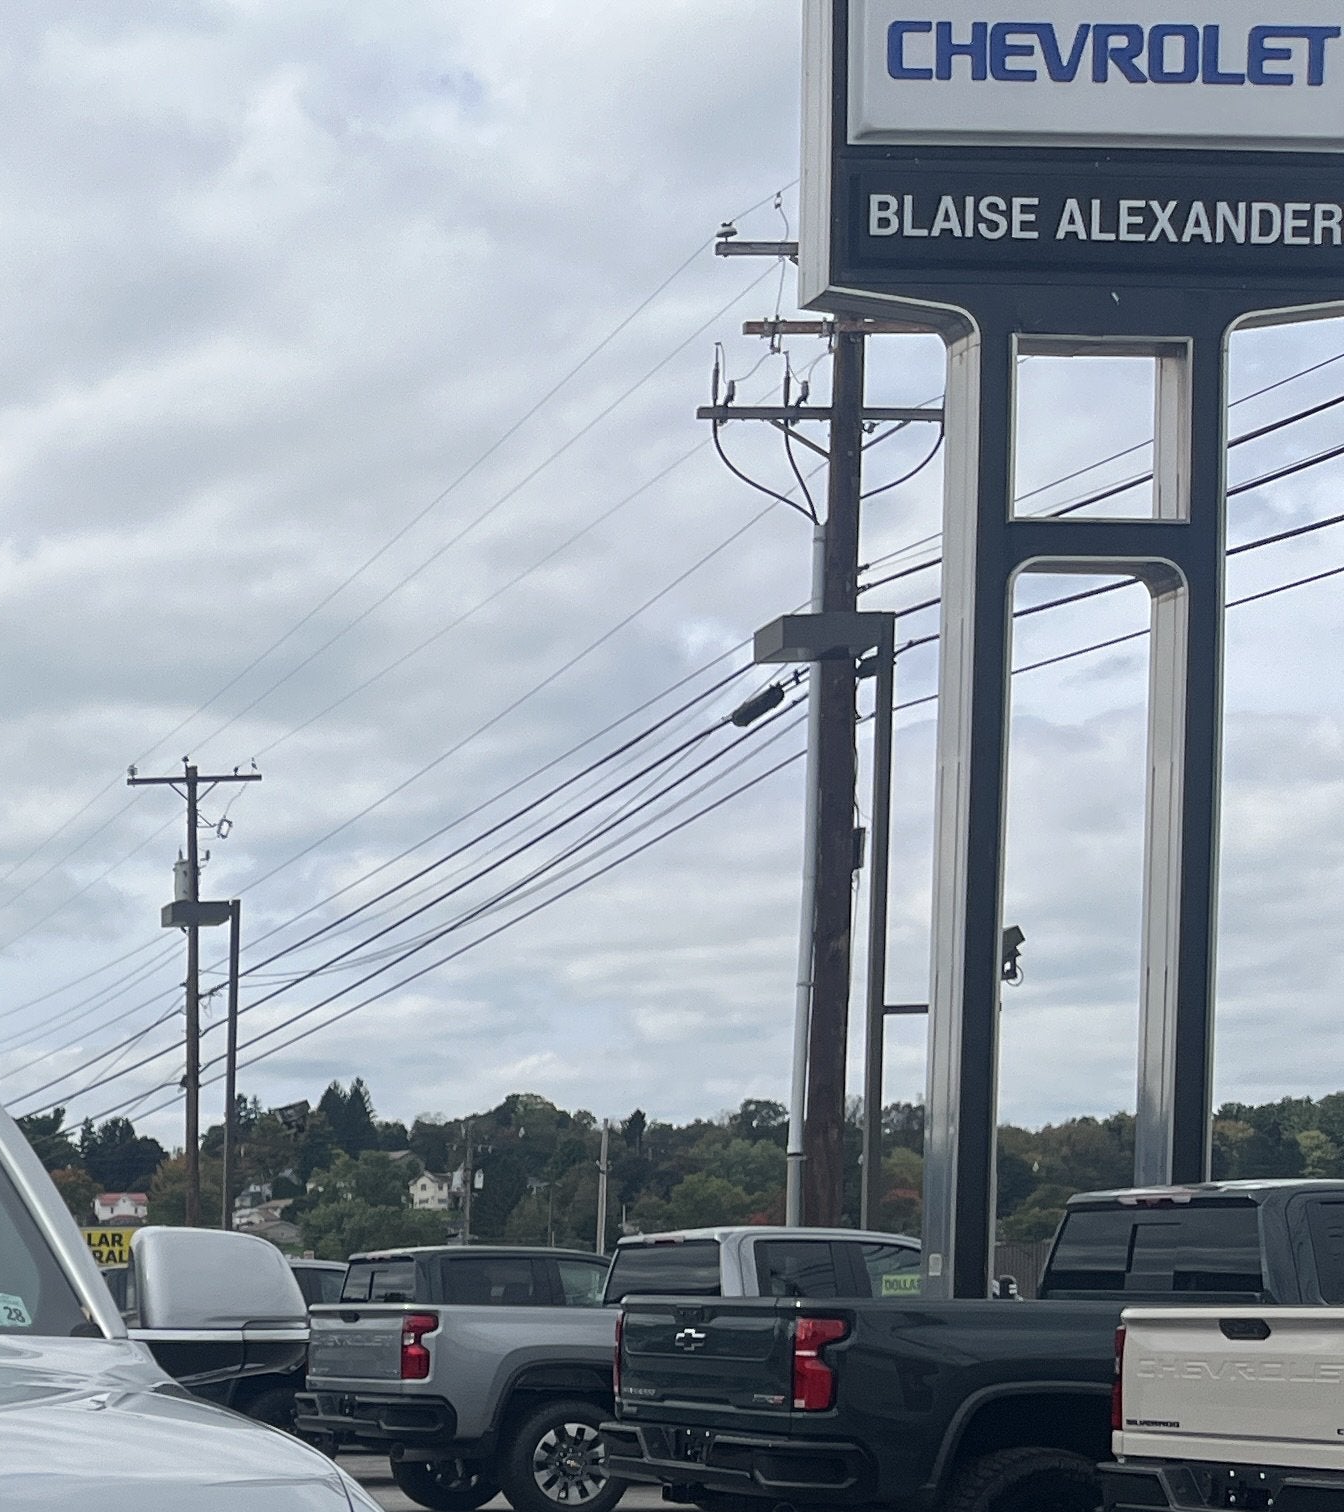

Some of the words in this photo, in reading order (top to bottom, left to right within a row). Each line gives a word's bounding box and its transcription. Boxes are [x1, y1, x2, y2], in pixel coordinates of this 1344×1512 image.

[887, 20, 1341, 86] CHEVROLET
[868, 193, 1040, 240] BLAISE
[1055, 198, 1344, 246] ALEXANDER
[3, 1306, 26, 1323] 28
[1136, 1359, 1344, 1384] CHEVROLE
